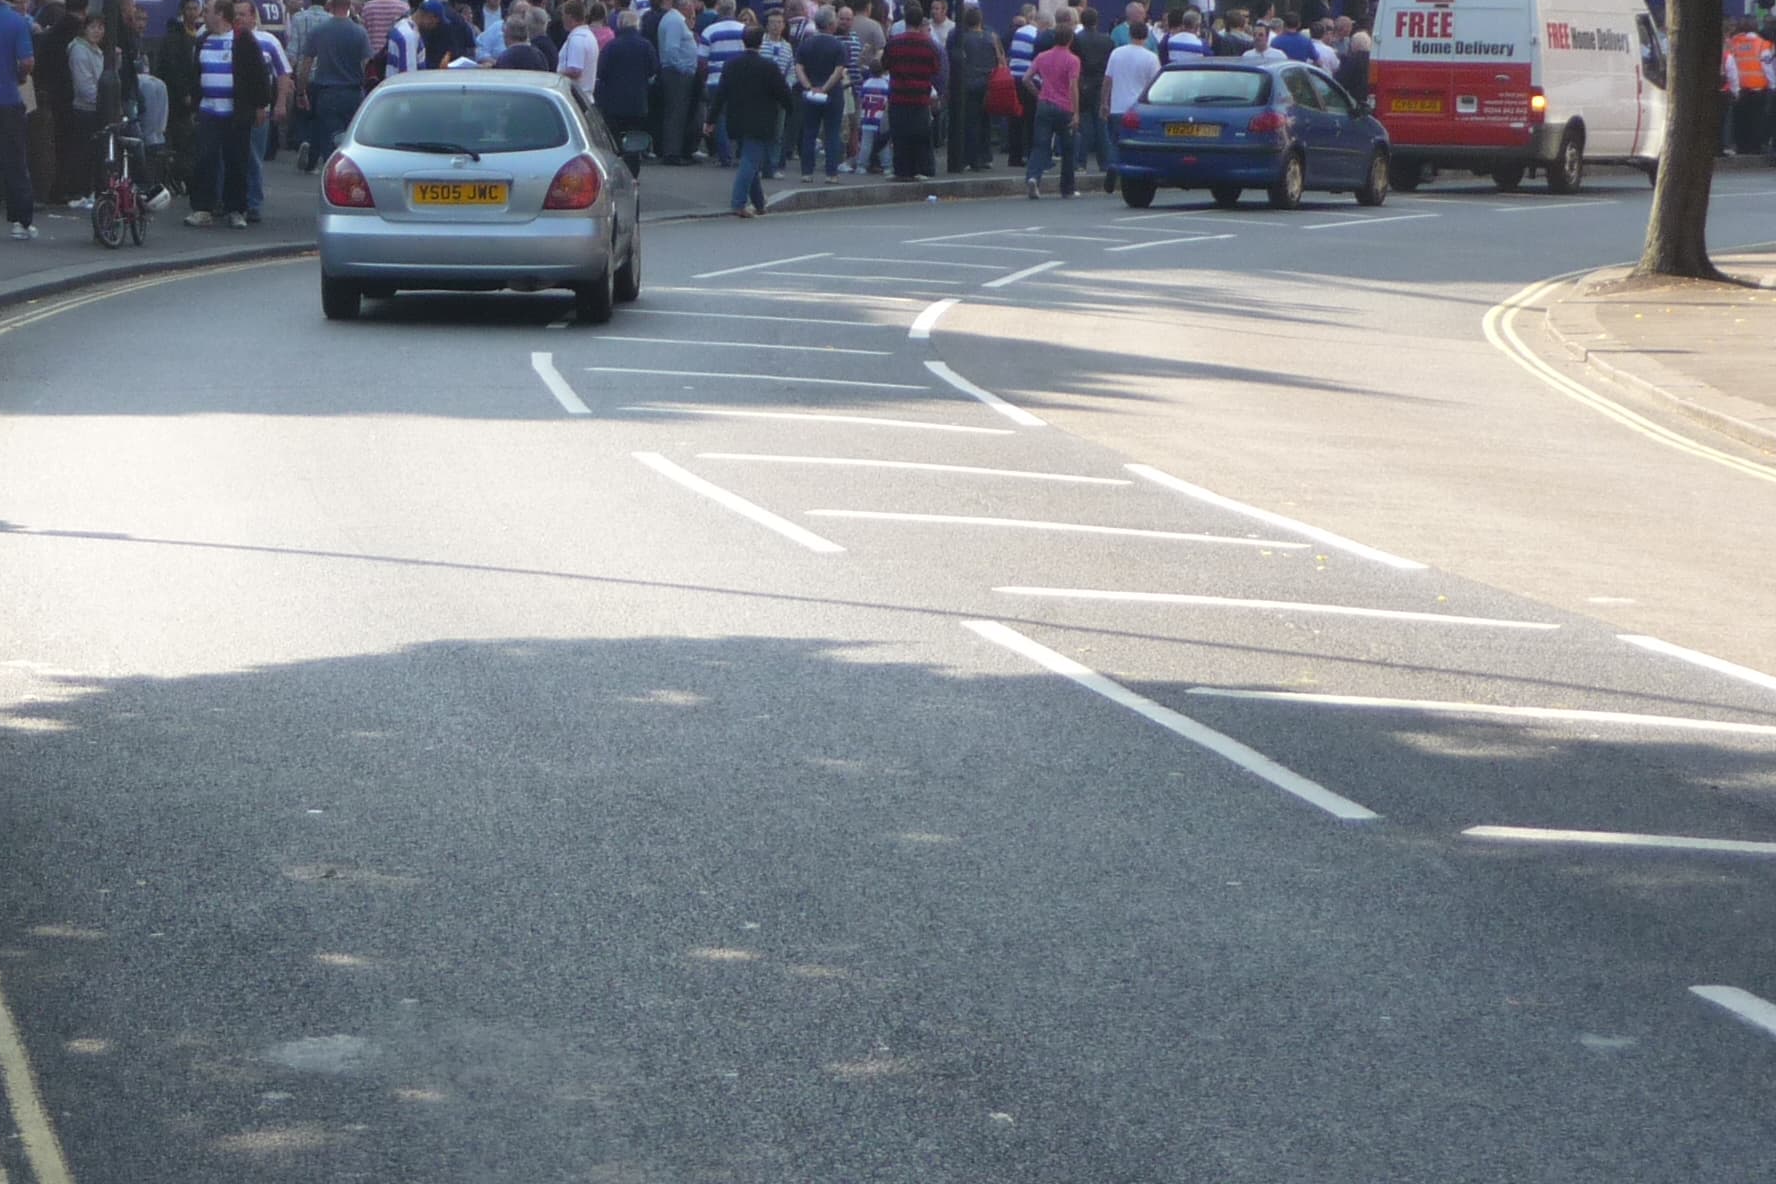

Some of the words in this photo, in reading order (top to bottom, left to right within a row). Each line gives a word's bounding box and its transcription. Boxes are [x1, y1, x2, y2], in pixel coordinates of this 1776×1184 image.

[1395, 11, 1453, 38] FREE
[1412, 40, 1451, 55] Home
[1455, 40, 1515, 57] Delivery
[1546, 22, 1571, 49] FREE
[1570, 27, 1597, 50] Home
[1596, 27, 1630, 54] Delivery
[418, 184, 462, 201] YS05
[467, 184, 499, 201] JWC
